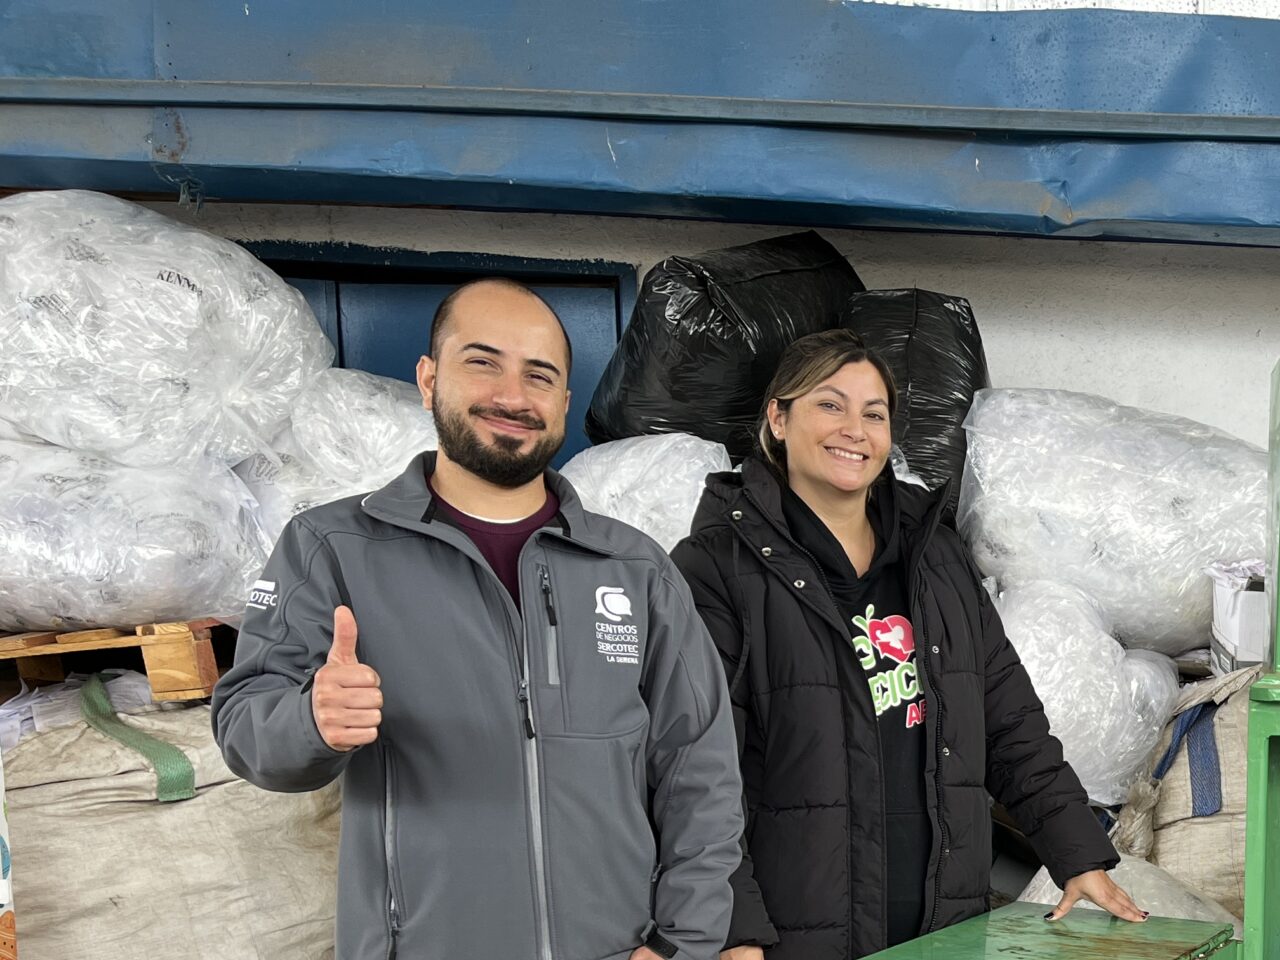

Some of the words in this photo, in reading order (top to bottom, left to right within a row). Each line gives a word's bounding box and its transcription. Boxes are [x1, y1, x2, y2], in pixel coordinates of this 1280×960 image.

[595, 622, 637, 635] CENTROS
[595, 631, 604, 640] DE
[604, 633, 638, 643] NEGOCIOS
[597, 641, 639, 653] SERCOTEC
[606, 655, 616, 663] LA
